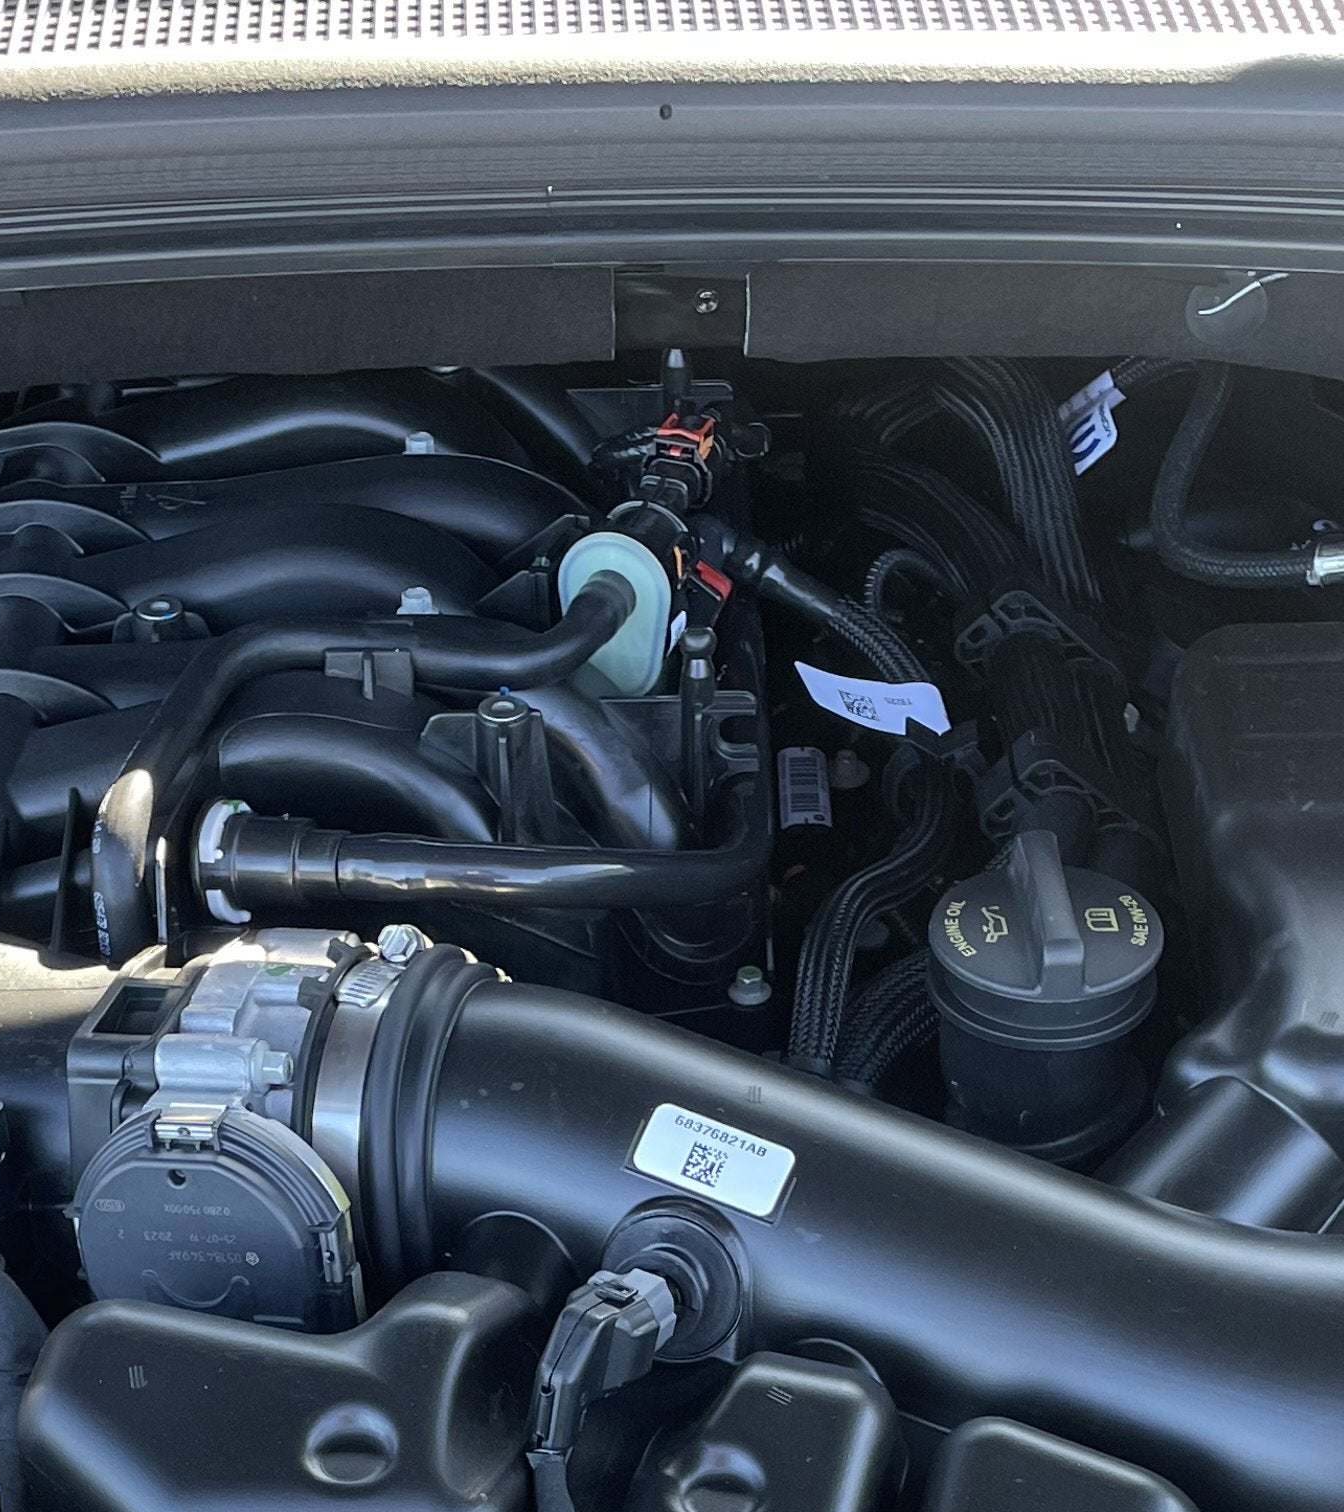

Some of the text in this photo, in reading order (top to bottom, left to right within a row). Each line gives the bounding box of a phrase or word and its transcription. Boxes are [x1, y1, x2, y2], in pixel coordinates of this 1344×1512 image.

[944, 899, 978, 957] ENGINE OIL
[1130, 923, 1149, 946] SAE
[674, 1114, 768, 1158] 68376821AB
